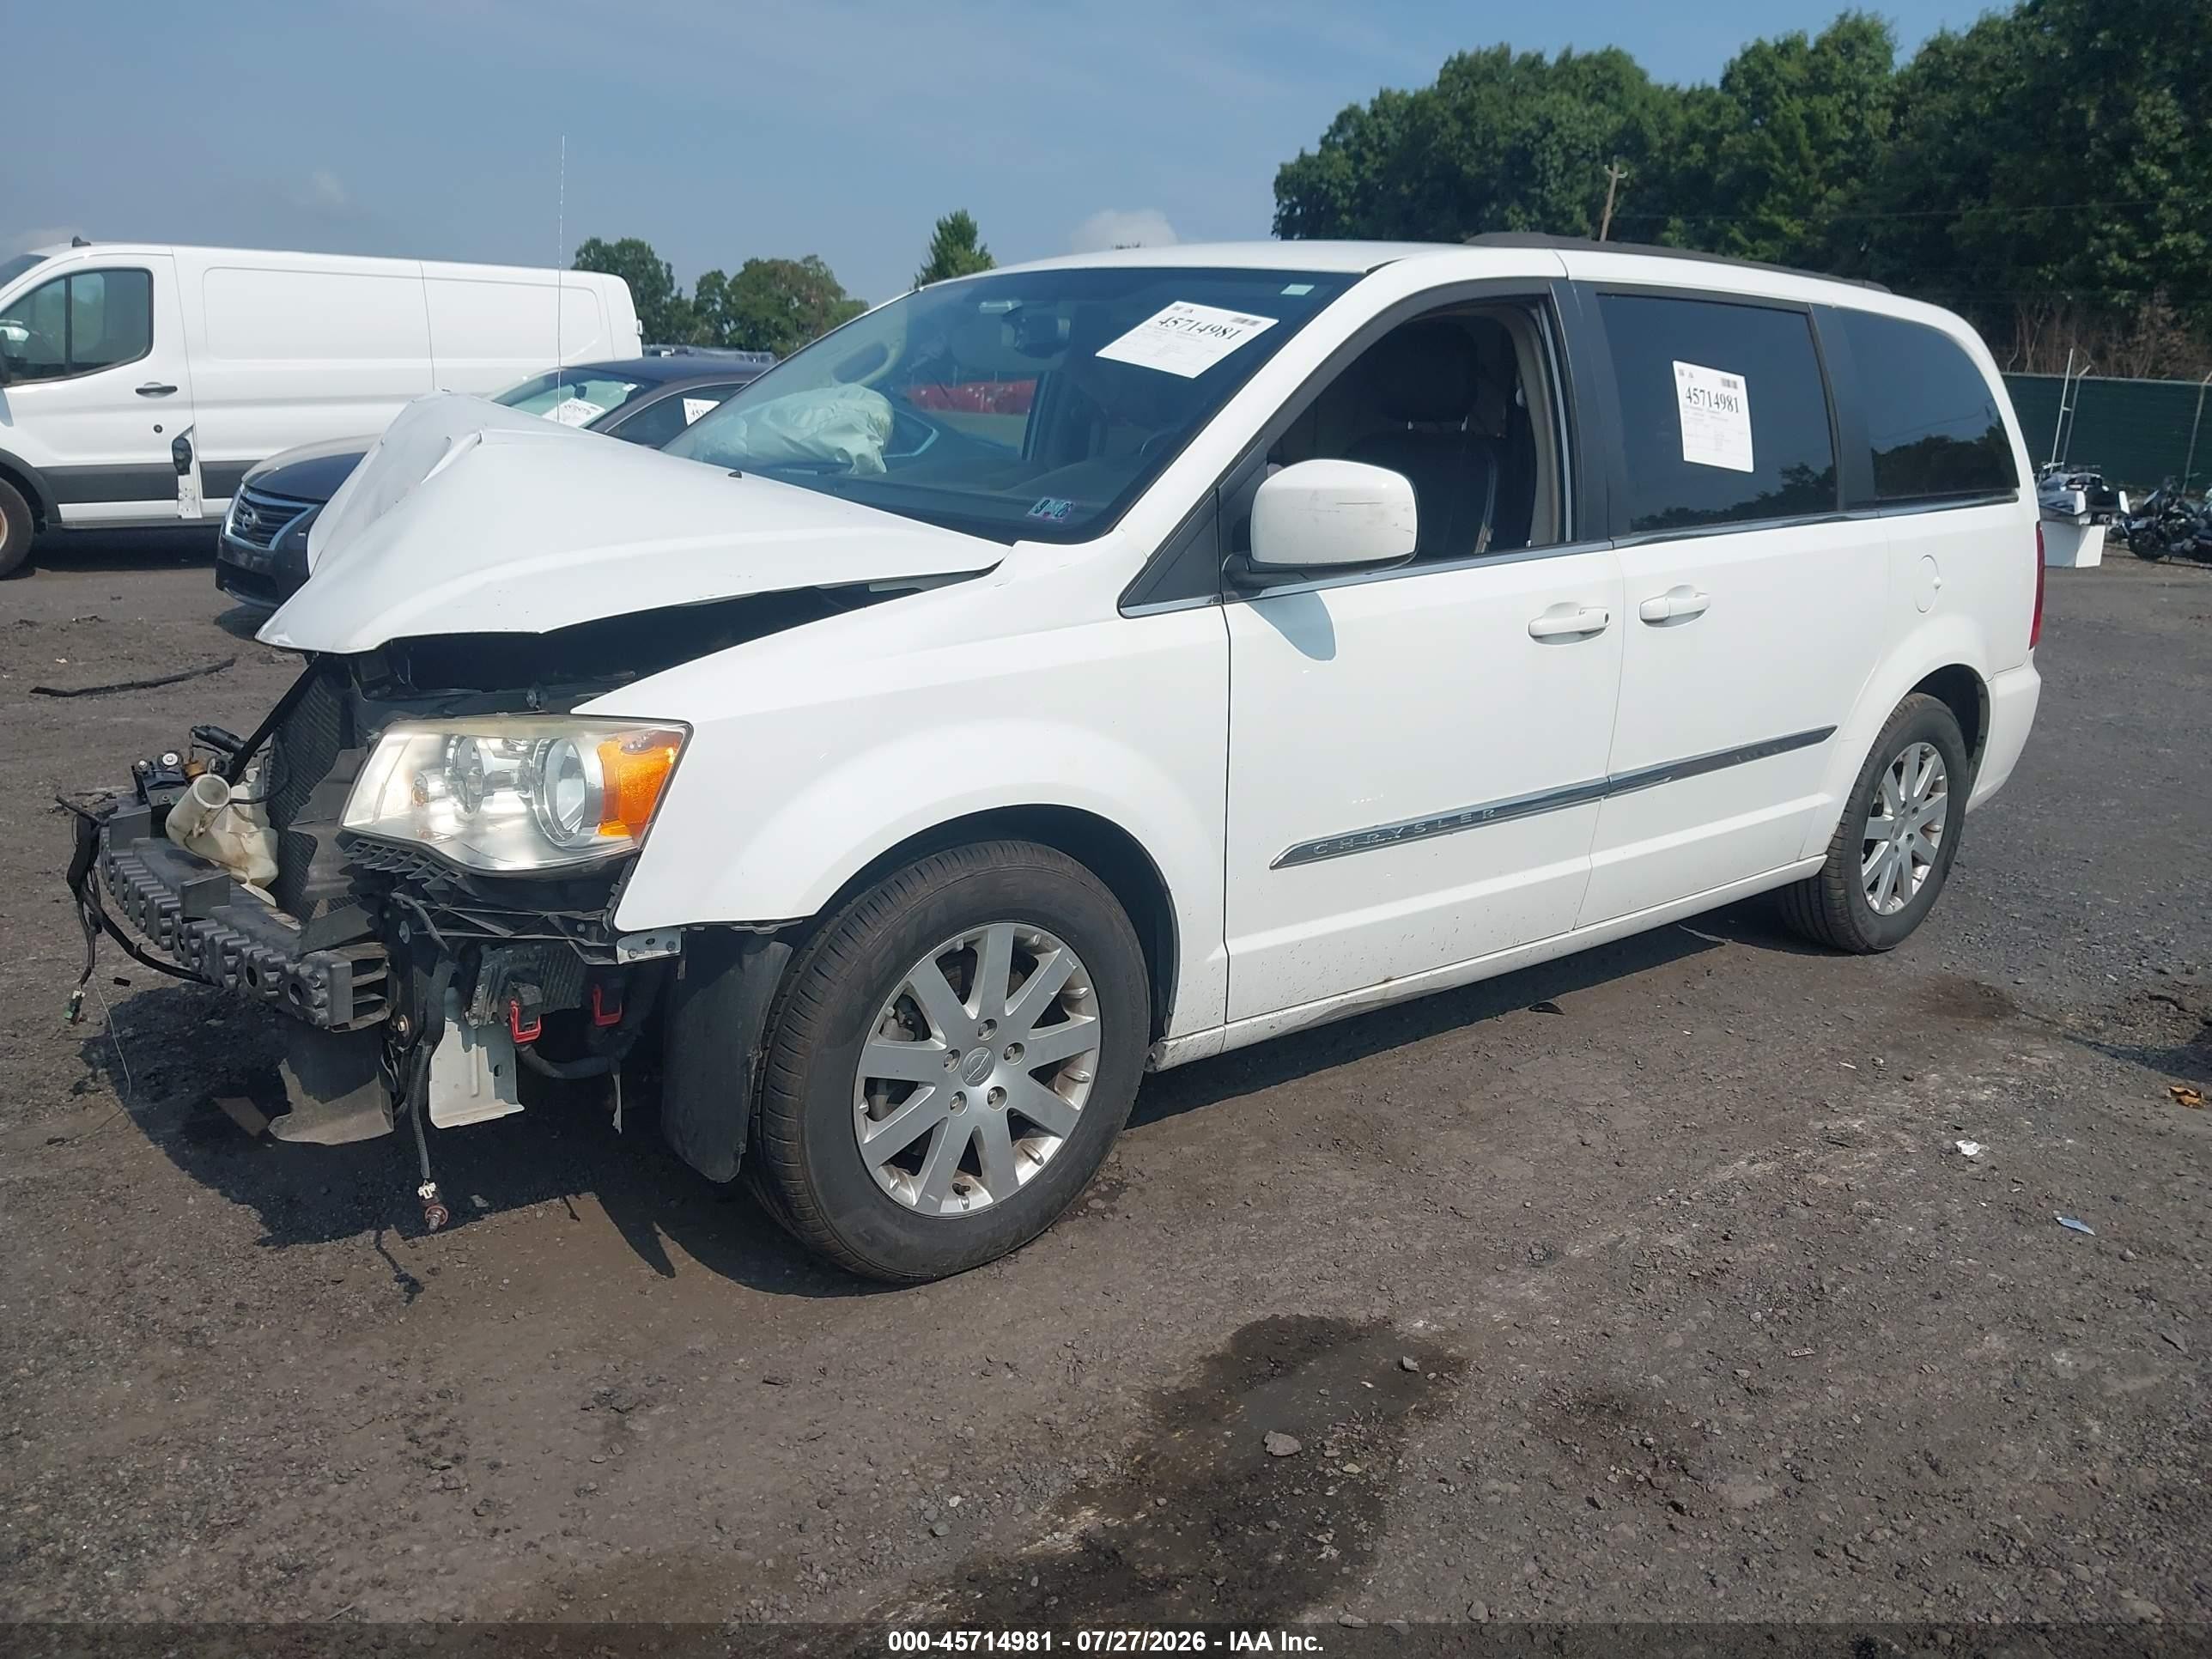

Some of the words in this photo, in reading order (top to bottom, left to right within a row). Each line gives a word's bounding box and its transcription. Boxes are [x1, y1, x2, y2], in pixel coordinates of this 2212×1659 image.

[1158, 315, 1243, 341] 45714981
[1686, 386, 1739, 414] 45714981
[1312, 808, 1496, 855] CHRYSLER
